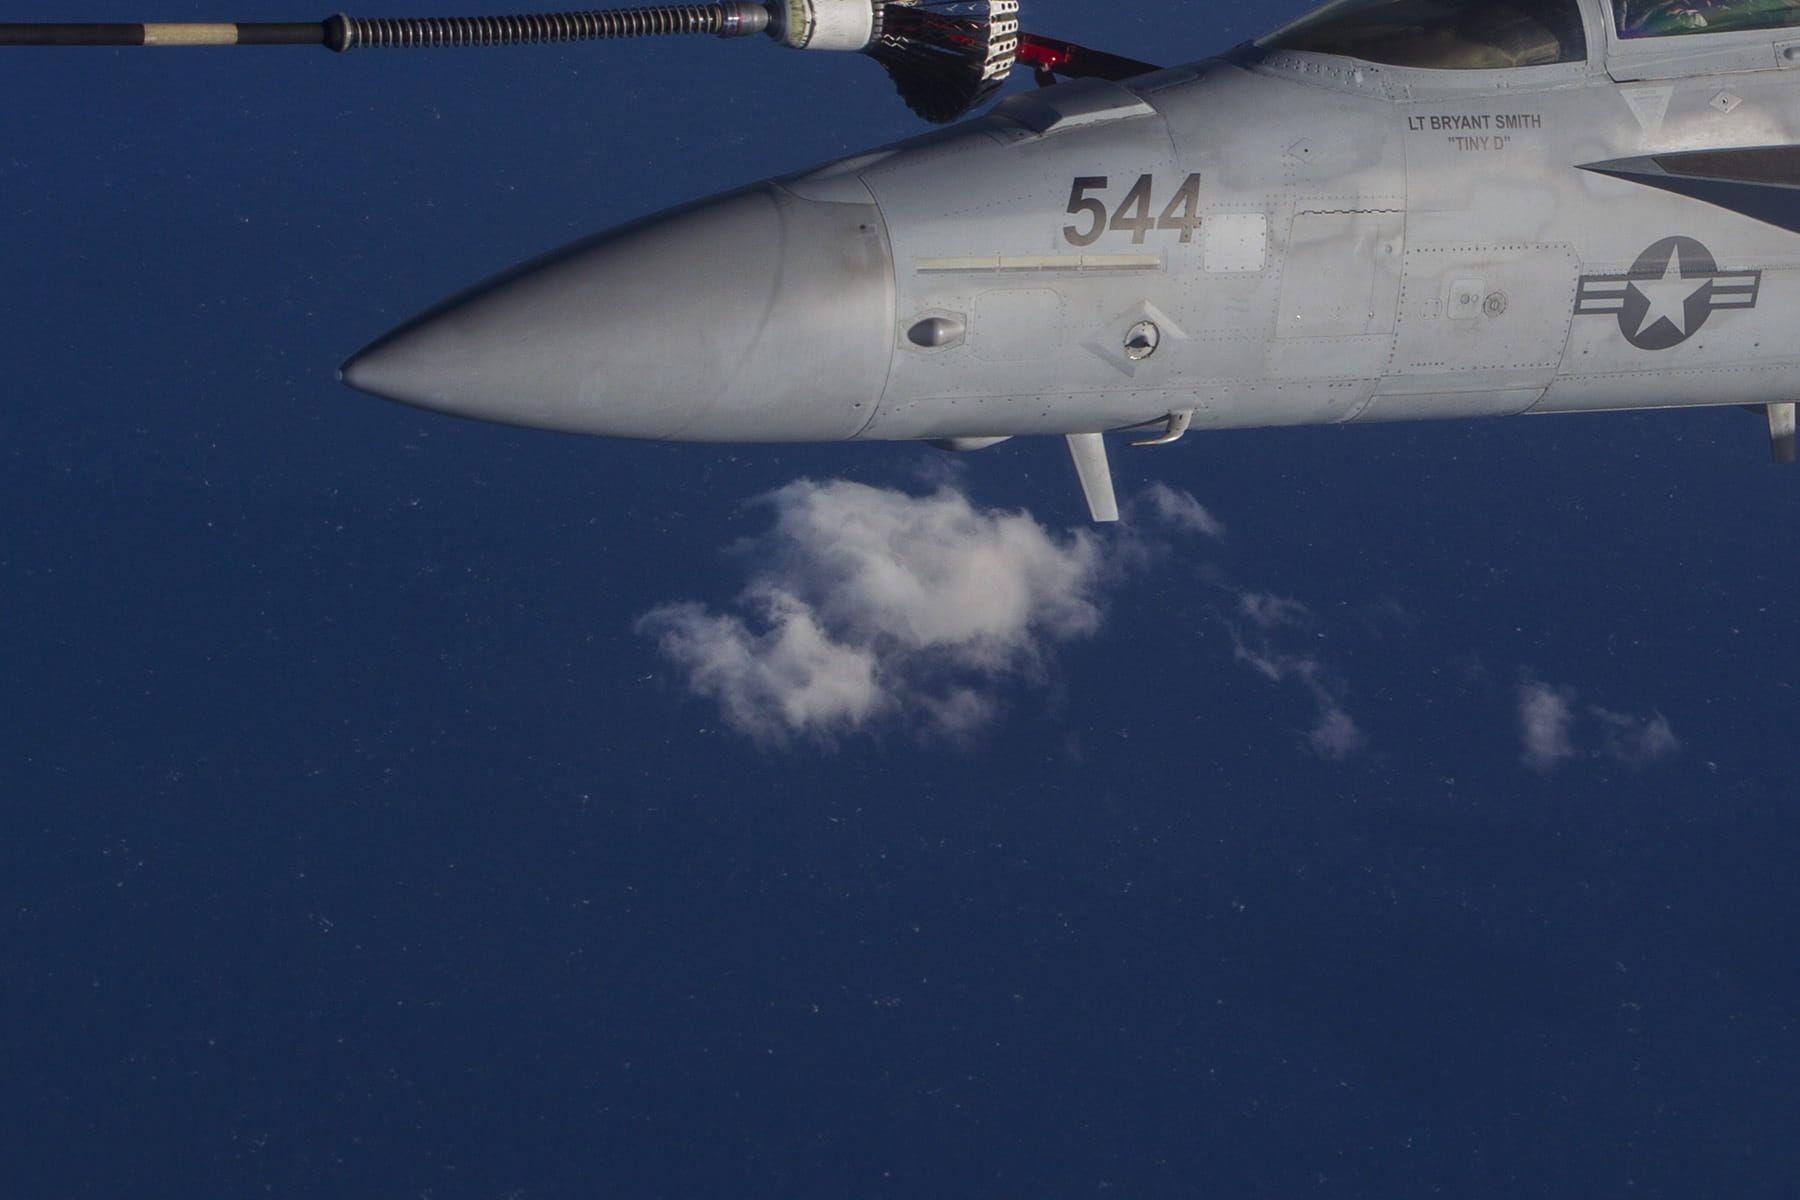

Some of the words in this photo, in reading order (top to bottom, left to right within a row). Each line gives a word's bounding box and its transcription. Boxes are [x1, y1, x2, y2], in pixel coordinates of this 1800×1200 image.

[1408, 116, 1425, 131] LT
[1430, 115, 1490, 130] BRYANT
[1495, 114, 1542, 129] SMITH
[1447, 136, 1489, 151] "TINY
[1493, 136, 1511, 150] D"
[1063, 173, 1202, 246] 544
